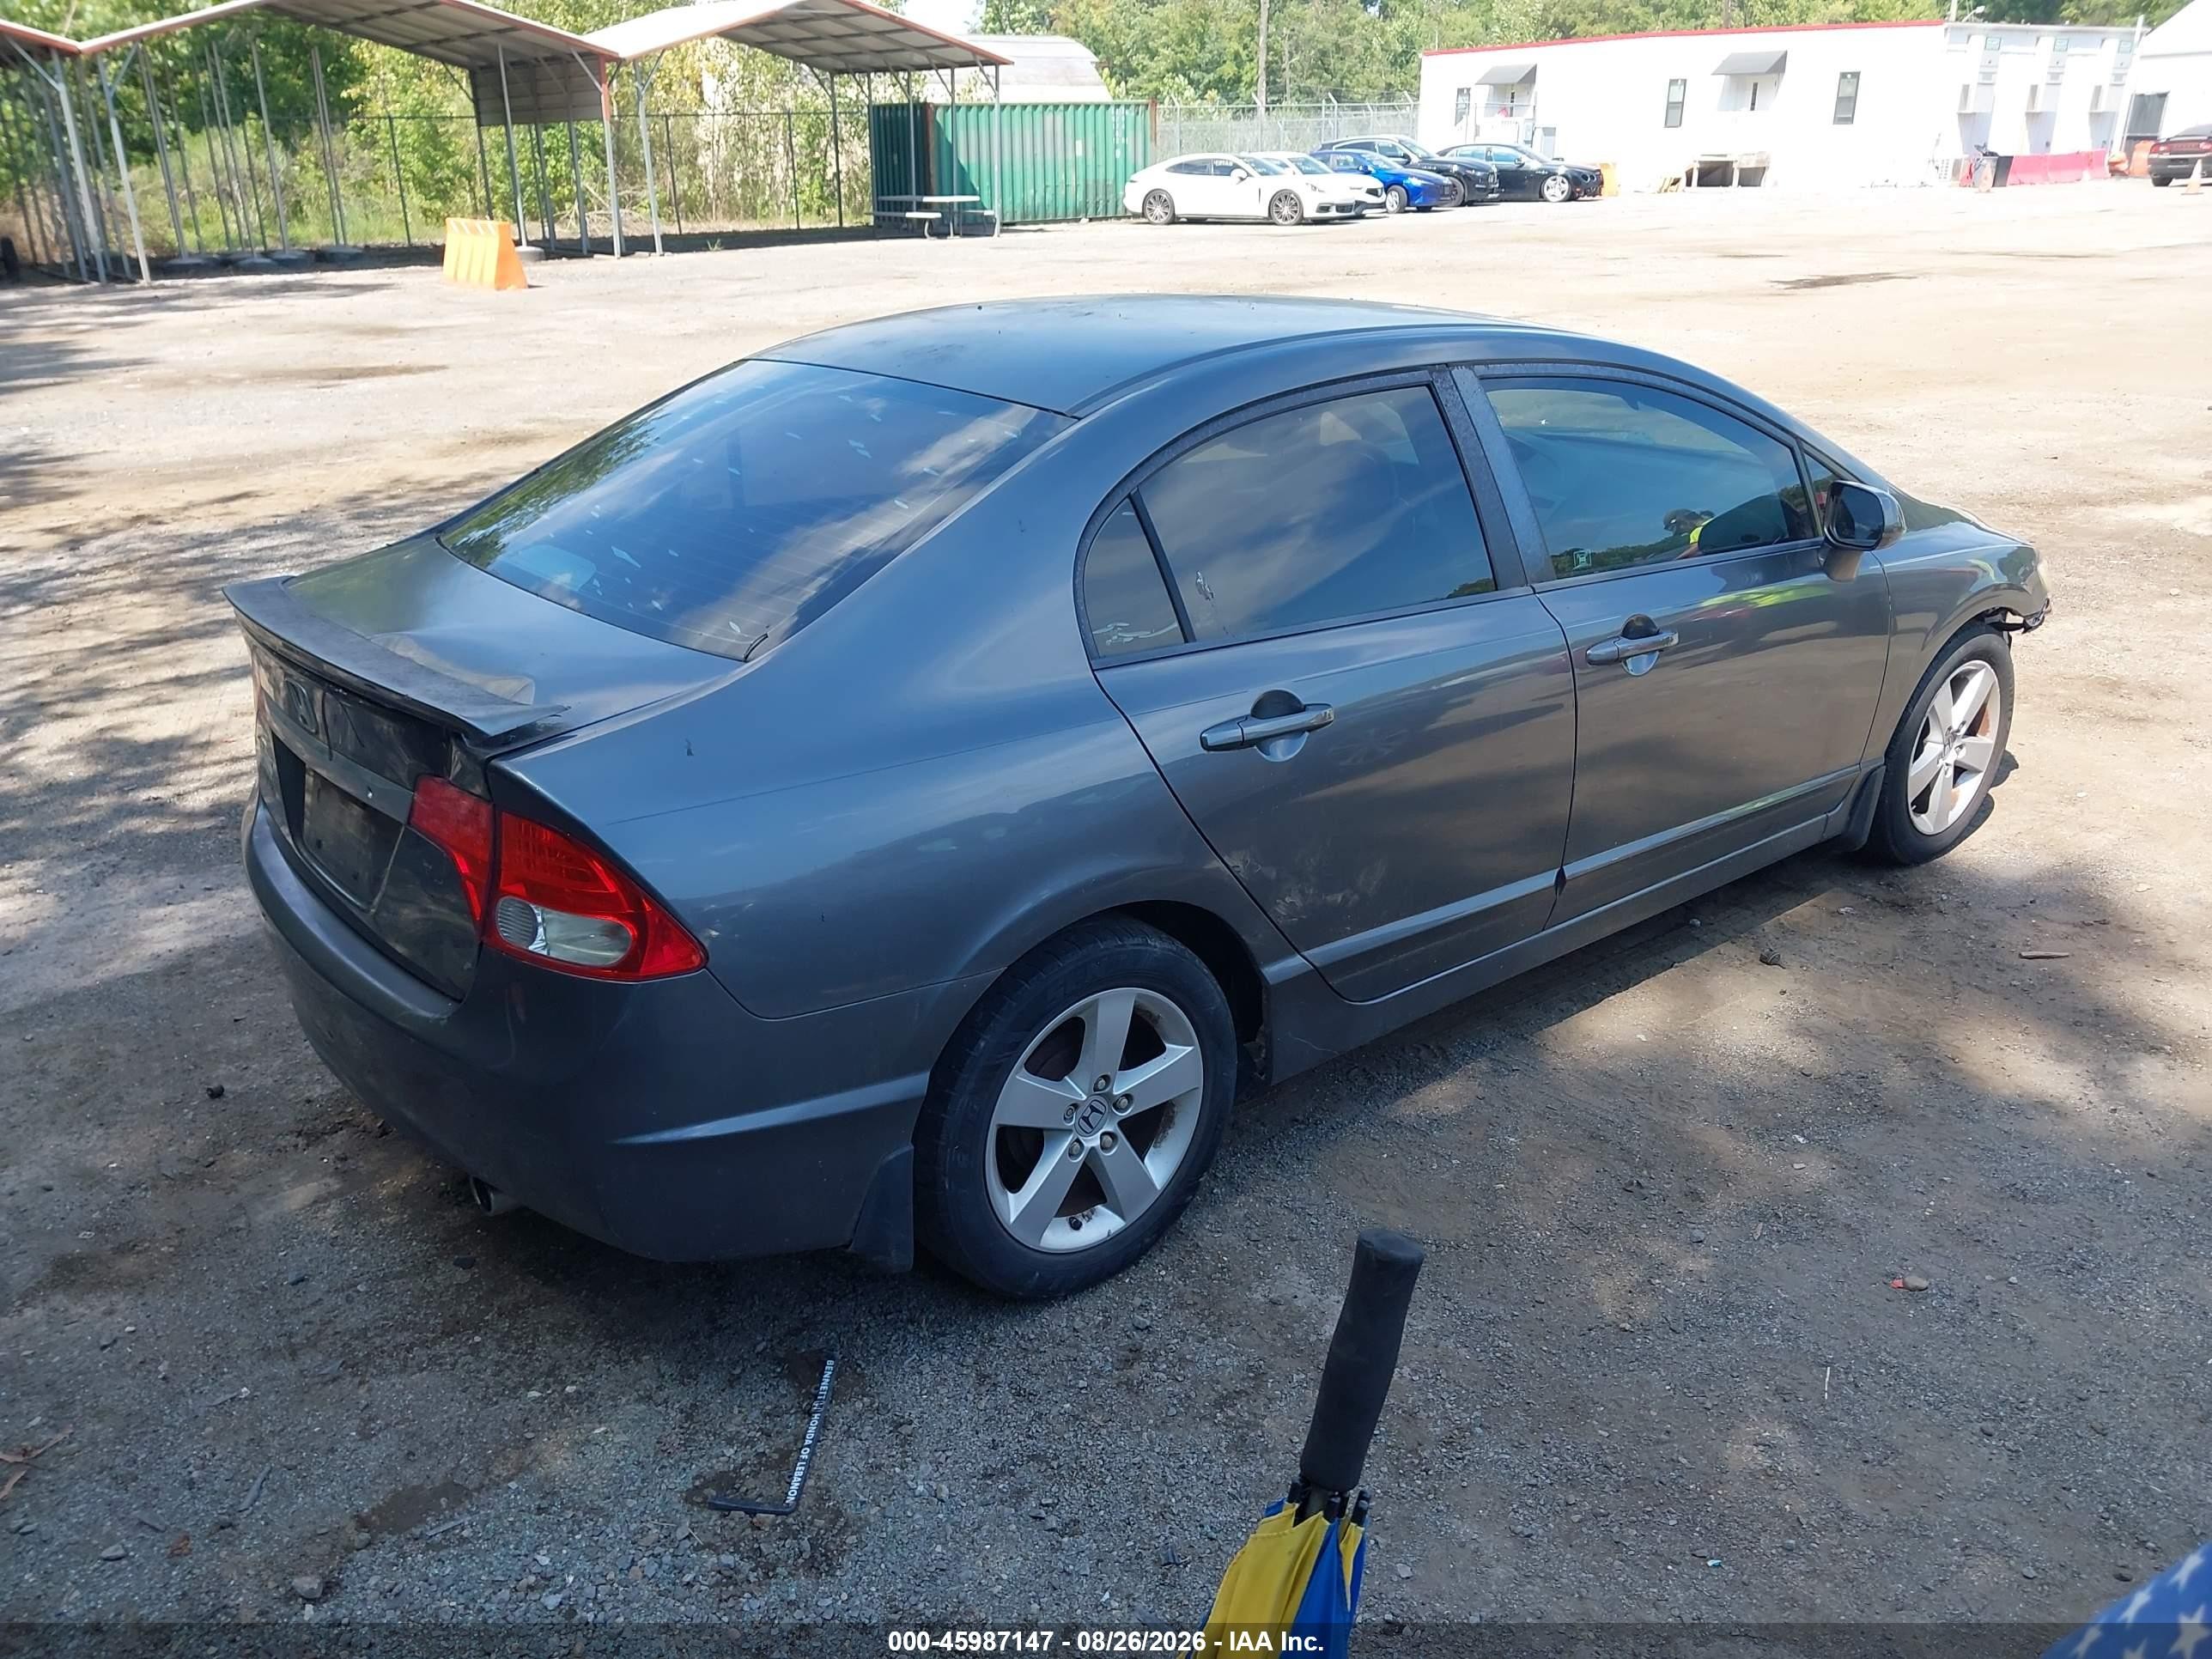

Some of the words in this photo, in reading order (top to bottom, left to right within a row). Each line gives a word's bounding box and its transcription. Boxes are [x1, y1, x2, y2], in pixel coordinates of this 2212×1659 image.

[817, 1359, 835, 1400] BENNETT
[803, 1413, 821, 1446] HONDA
[799, 1447, 811, 1461] OF
[785, 1462, 806, 1504] LEBANON
